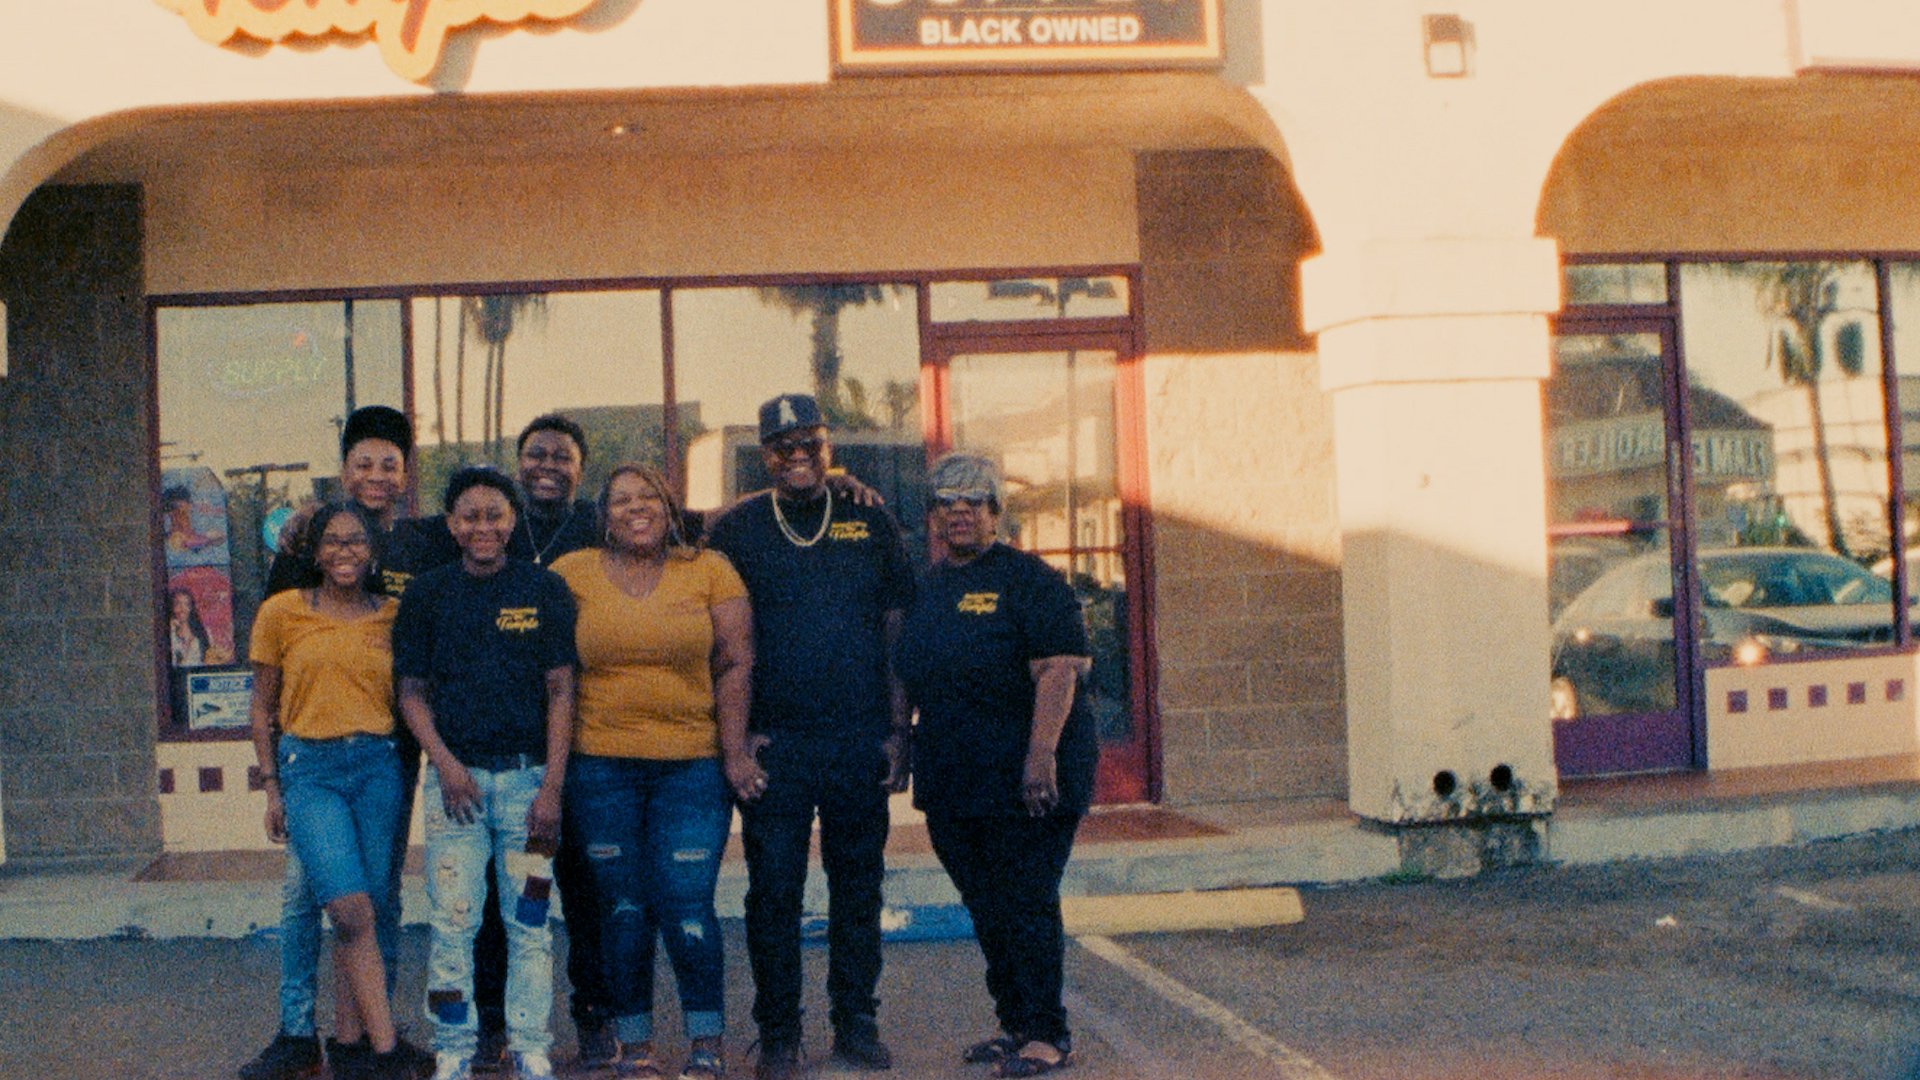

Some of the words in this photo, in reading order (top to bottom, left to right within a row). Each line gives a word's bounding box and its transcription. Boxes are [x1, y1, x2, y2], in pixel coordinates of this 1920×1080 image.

[921, 18, 1022, 45] BLACK
[1029, 16, 1140, 43] OWNED
[226, 355, 327, 385] SUPPLY
